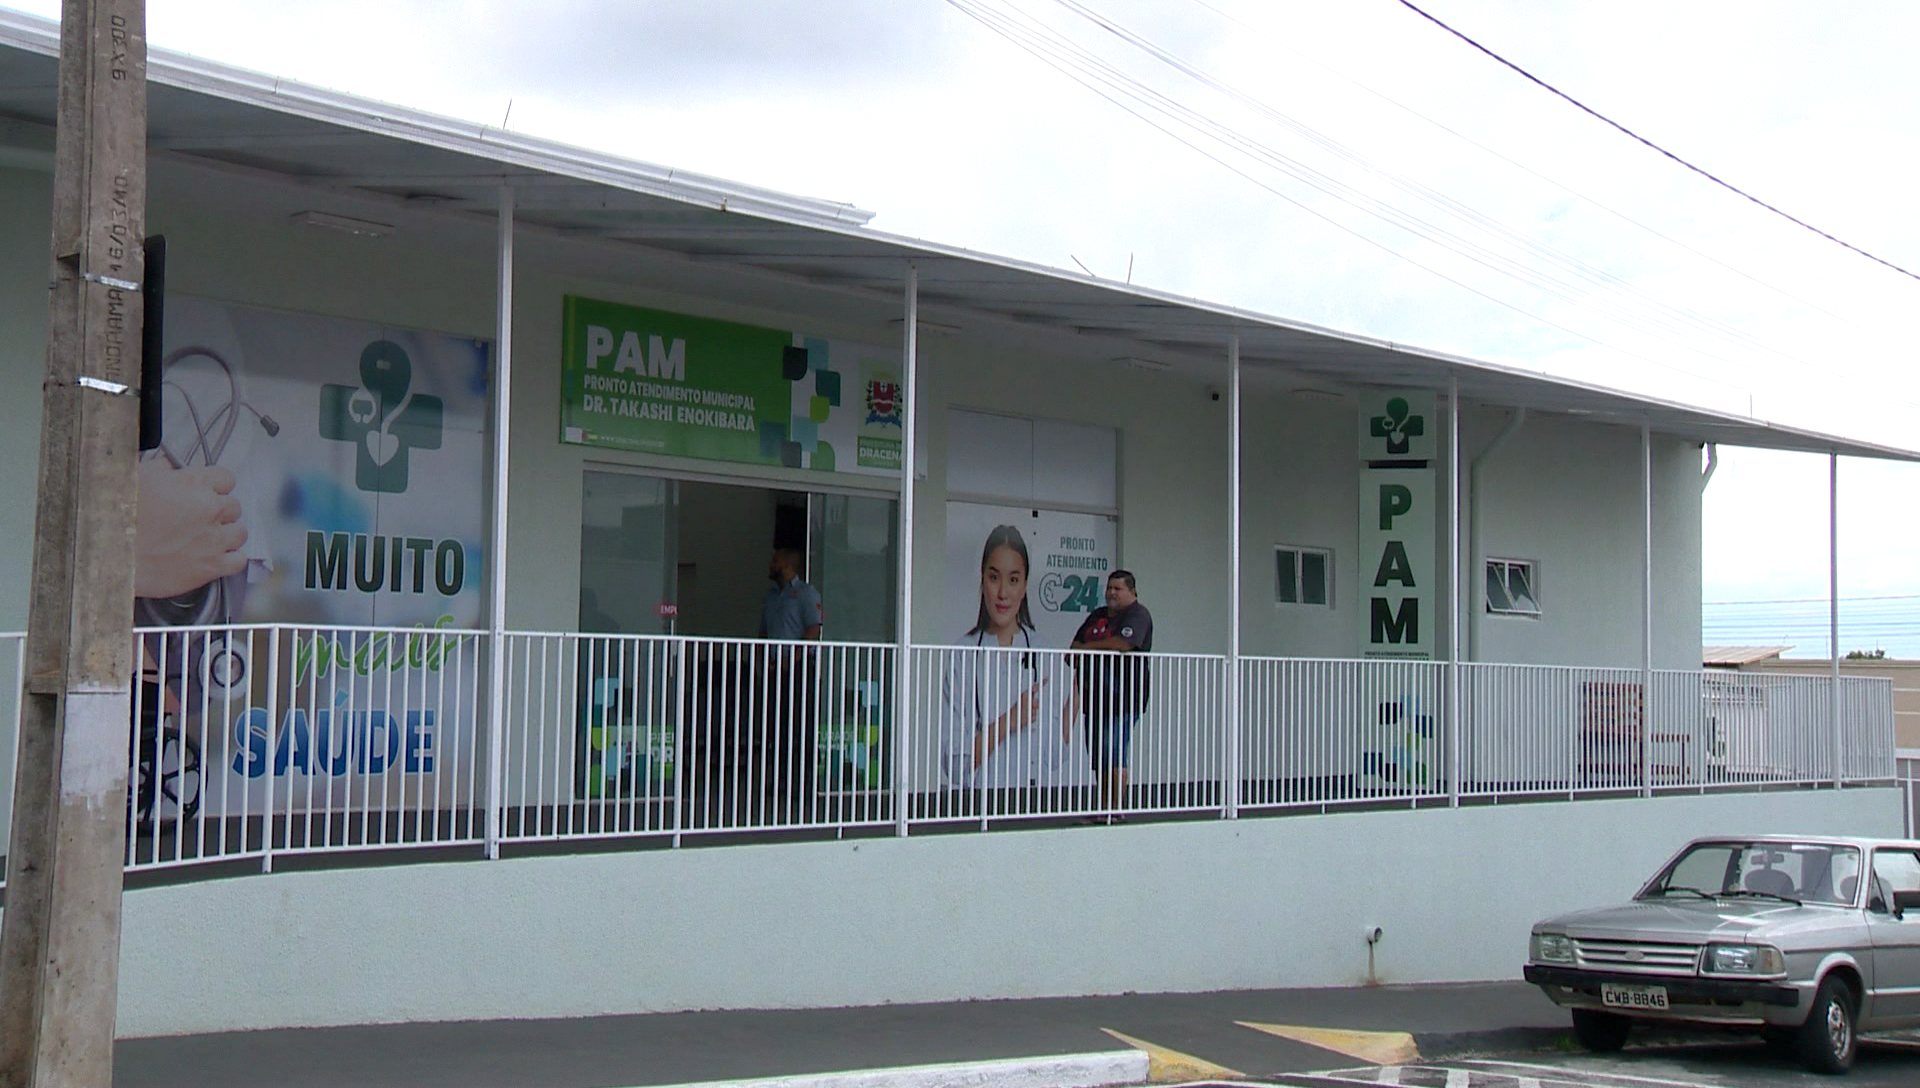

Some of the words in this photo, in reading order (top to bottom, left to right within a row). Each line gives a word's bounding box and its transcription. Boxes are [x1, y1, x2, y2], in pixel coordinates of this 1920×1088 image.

[586, 324, 686, 382] PAM
[583, 374, 628, 395] PRONTO
[628, 381, 702, 404] ATENDIMENTO
[702, 390, 756, 411] MUNICIPAL
[583, 394, 608, 414] DR.
[610, 397, 673, 422] TAKASHI
[677, 406, 756, 432] ENOKIBARA
[304, 530, 466, 597] MUITO
[1046, 554, 1108, 571] ATENDIMENTO
[1060, 536, 1096, 552] PRONTO
[1370, 483, 1419, 644] PAM
[1060, 574, 1100, 613] 24
[295, 614, 473, 688] mais
[232, 689, 435, 779] SAÚDE
